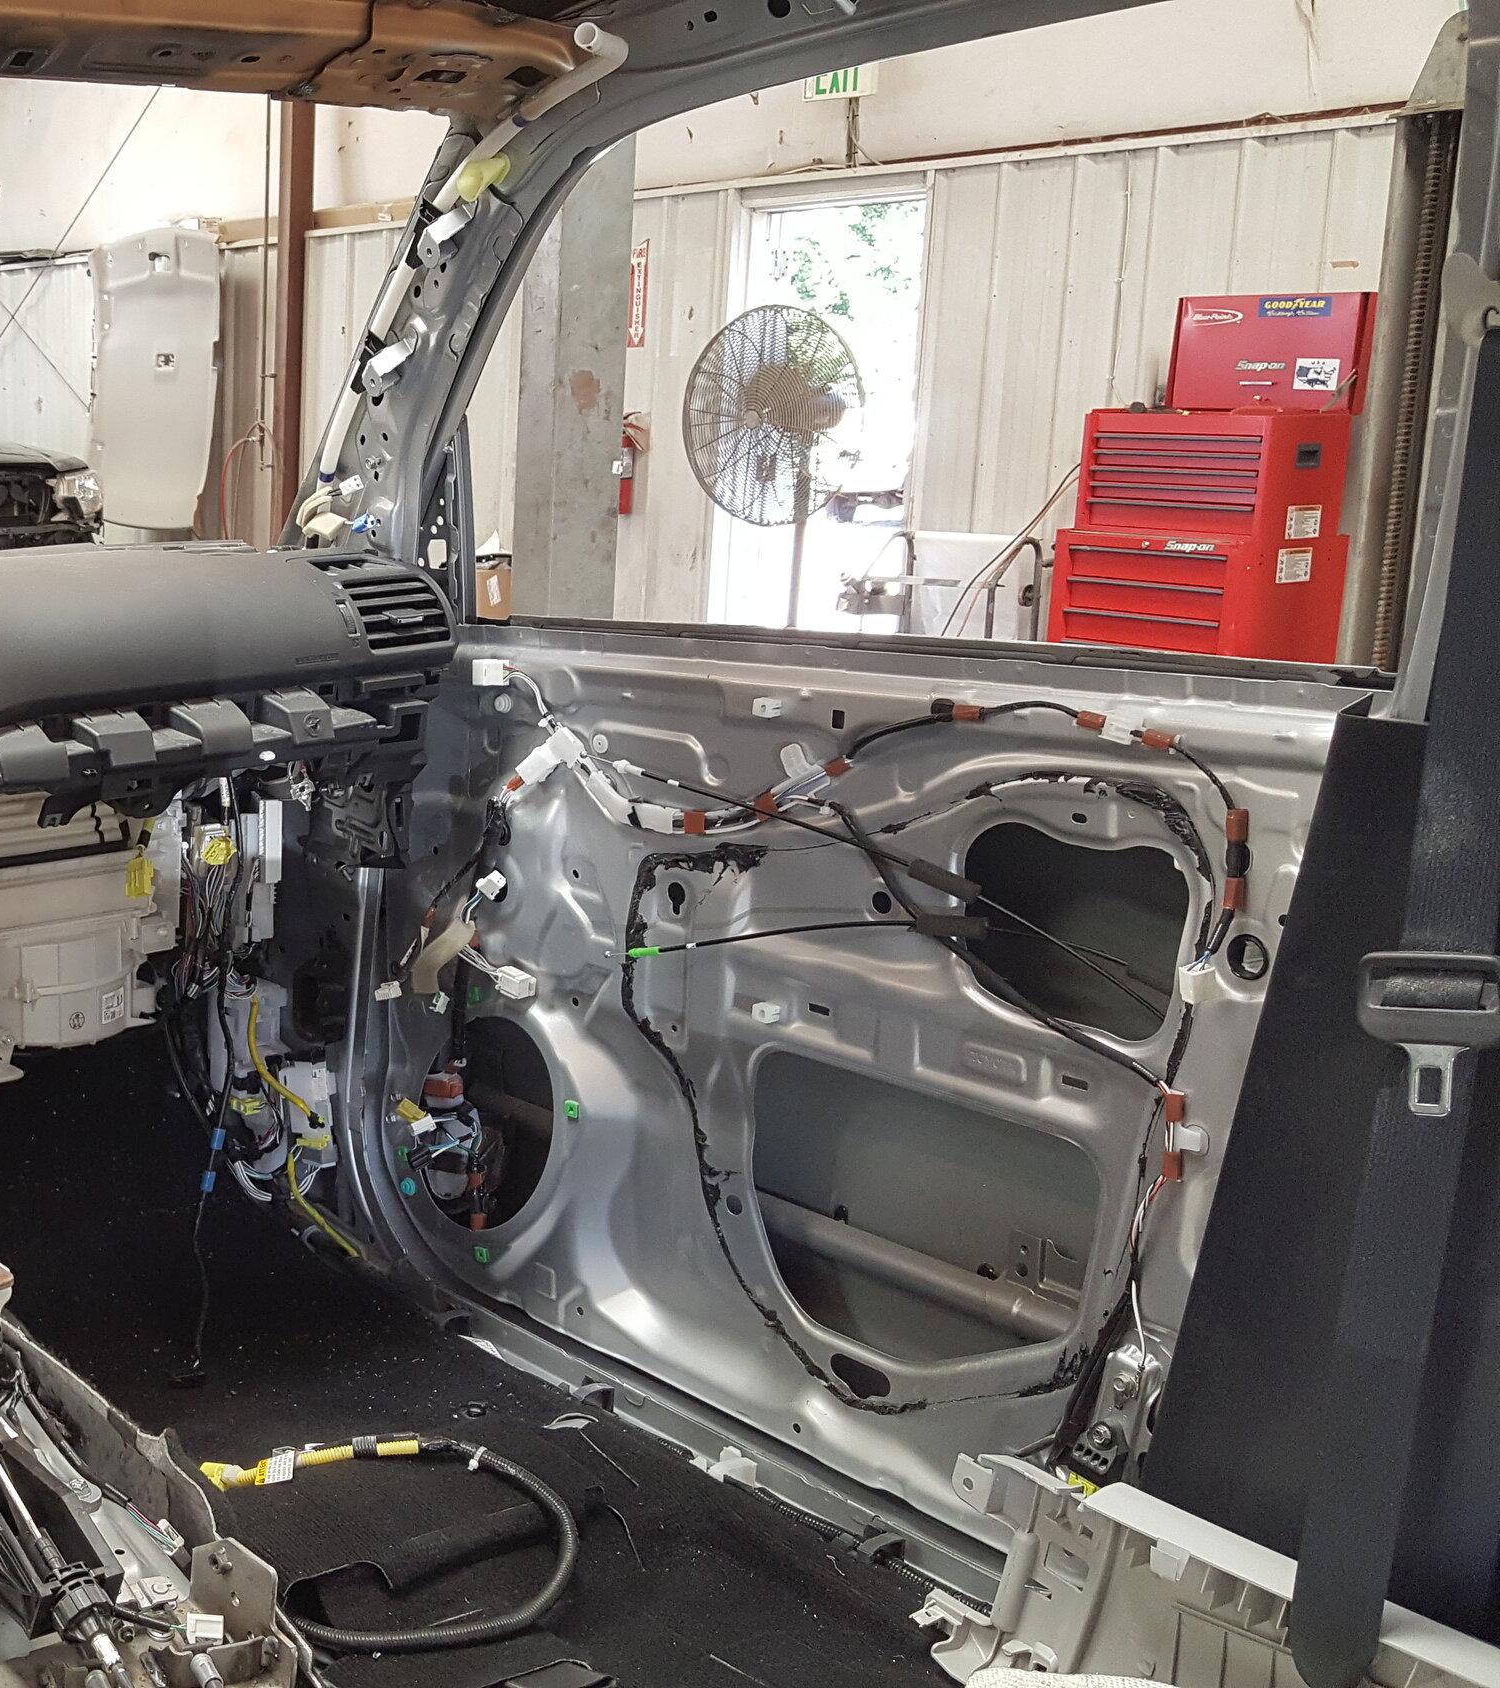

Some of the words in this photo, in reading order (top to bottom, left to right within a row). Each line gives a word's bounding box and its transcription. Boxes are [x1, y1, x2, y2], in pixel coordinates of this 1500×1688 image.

[631, 247, 647, 259] FIRE
[633, 261, 643, 339] EXTINGUISHER
[1235, 360, 1286, 372] Snap-on
[1164, 540, 1216, 553] Snap-on
